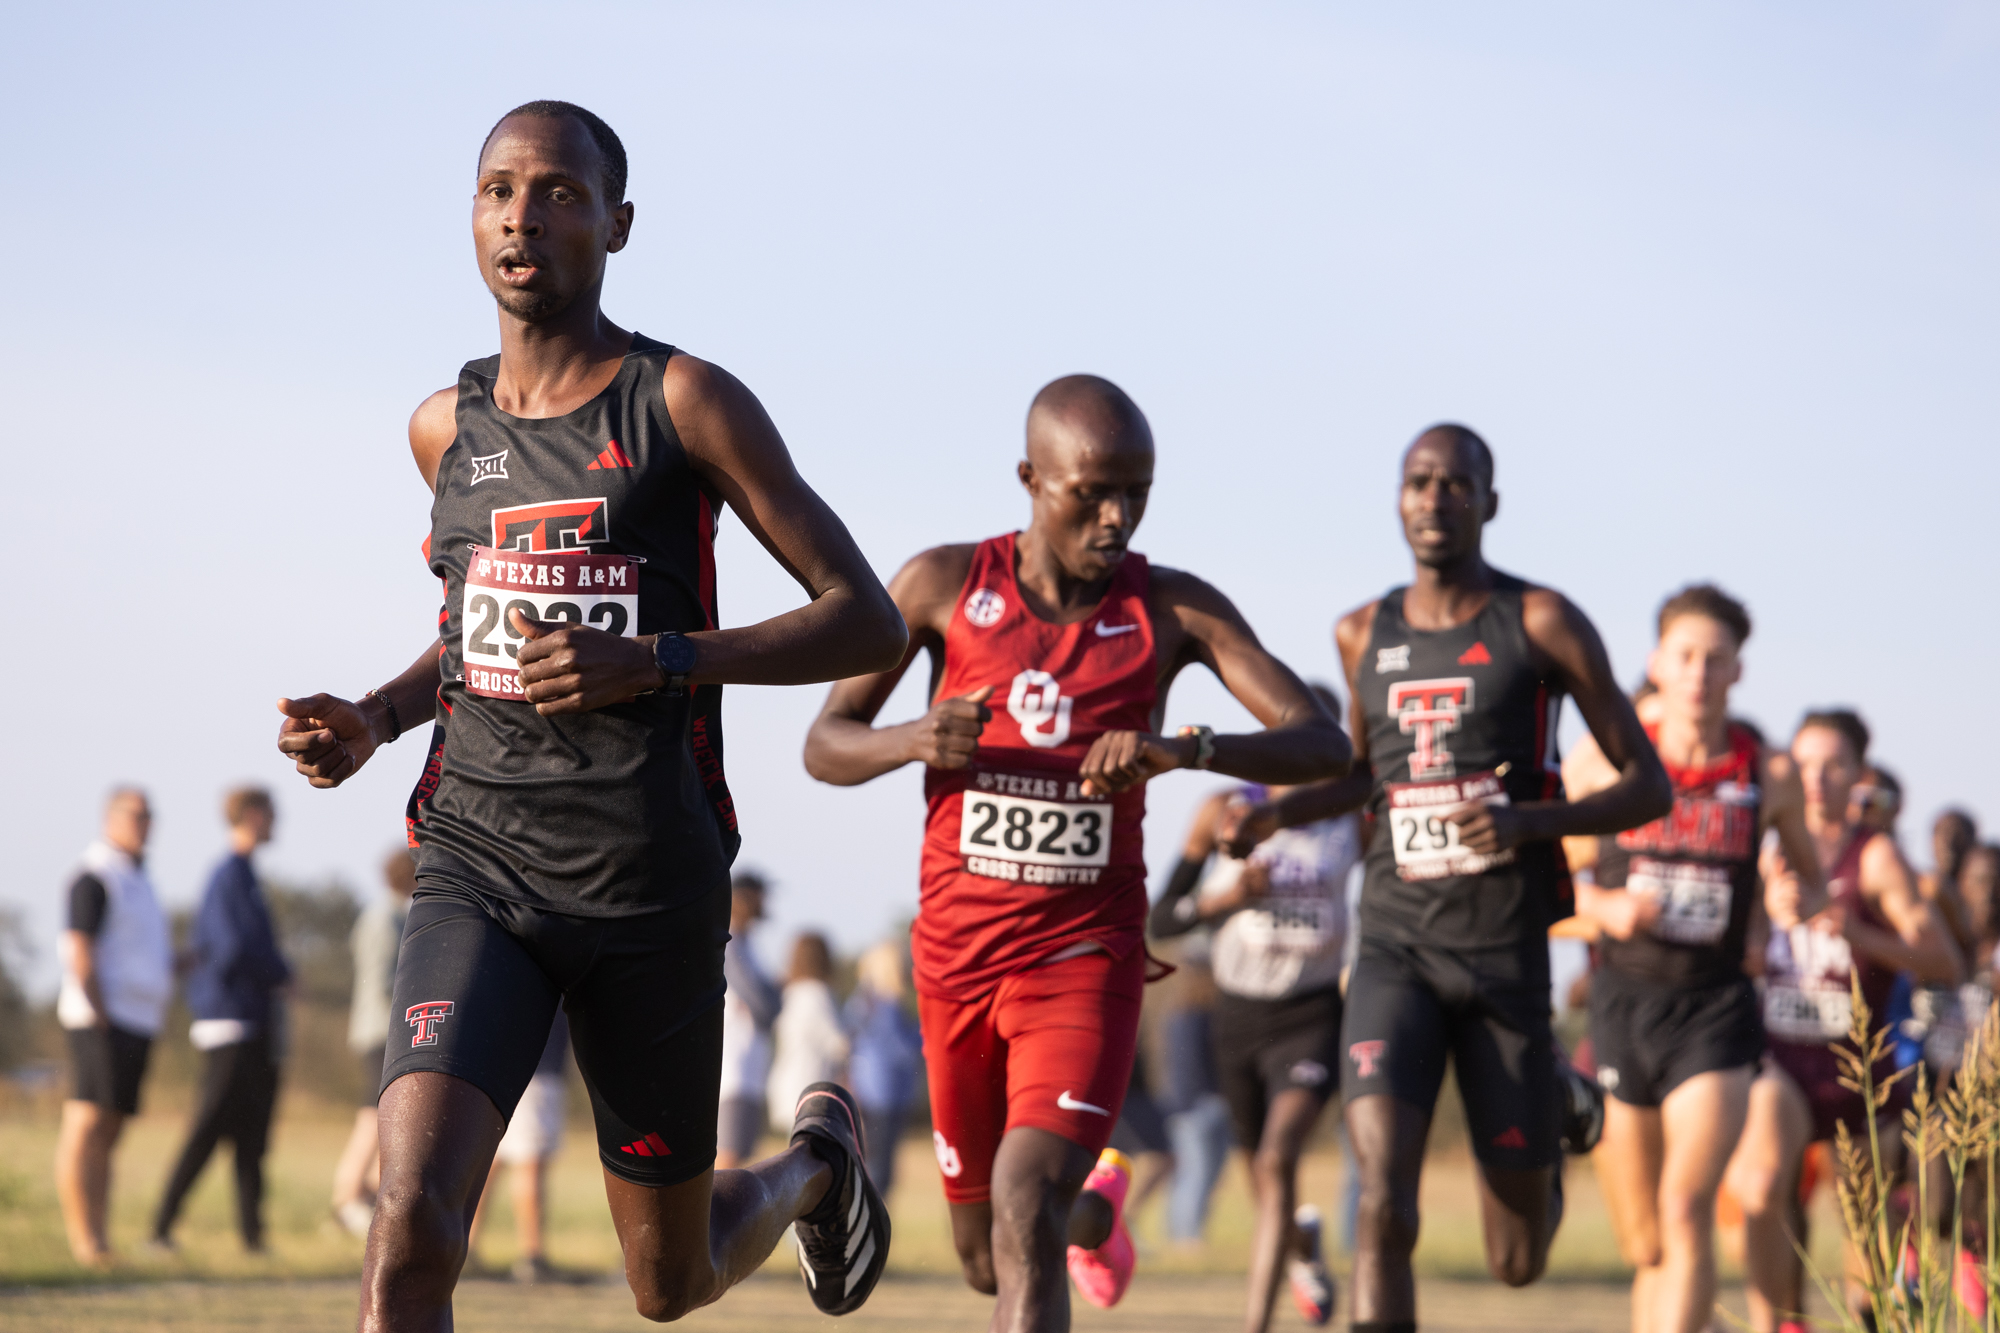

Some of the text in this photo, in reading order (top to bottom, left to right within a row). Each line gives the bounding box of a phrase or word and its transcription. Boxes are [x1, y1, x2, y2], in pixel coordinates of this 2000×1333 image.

[493, 560, 565, 586] TEXAS
[577, 565, 627, 587] A&M
[471, 669, 526, 694] CROSS
[693, 714, 726, 791] WRECK
[994, 772, 1059, 799] TEXAS
[969, 801, 1104, 857] 2823
[968, 855, 1100, 884] CROSS COUNTRY
